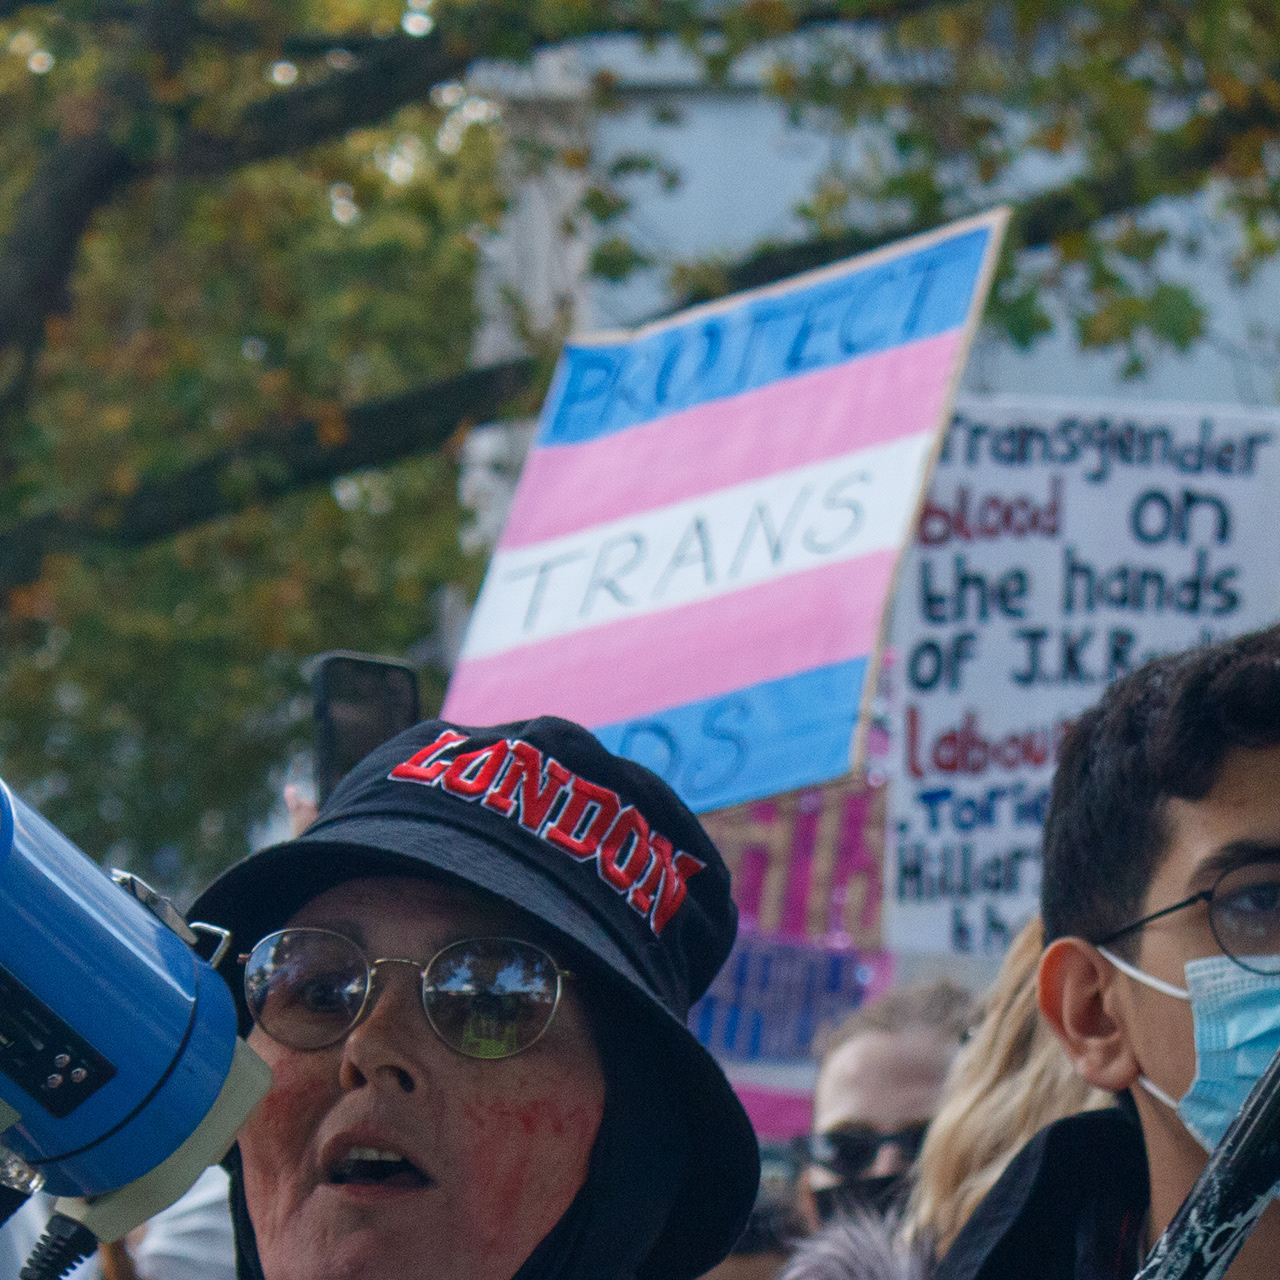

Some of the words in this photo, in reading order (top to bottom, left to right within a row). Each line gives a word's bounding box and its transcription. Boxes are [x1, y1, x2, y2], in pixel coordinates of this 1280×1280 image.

[552, 253, 960, 436] PROTECT
[503, 470, 873, 630] TRANS
[920, 554, 1031, 625] the
[1063, 547, 1240, 617] hands
[1131, 487, 1231, 545] on
[388, 729, 708, 938] LONDON
